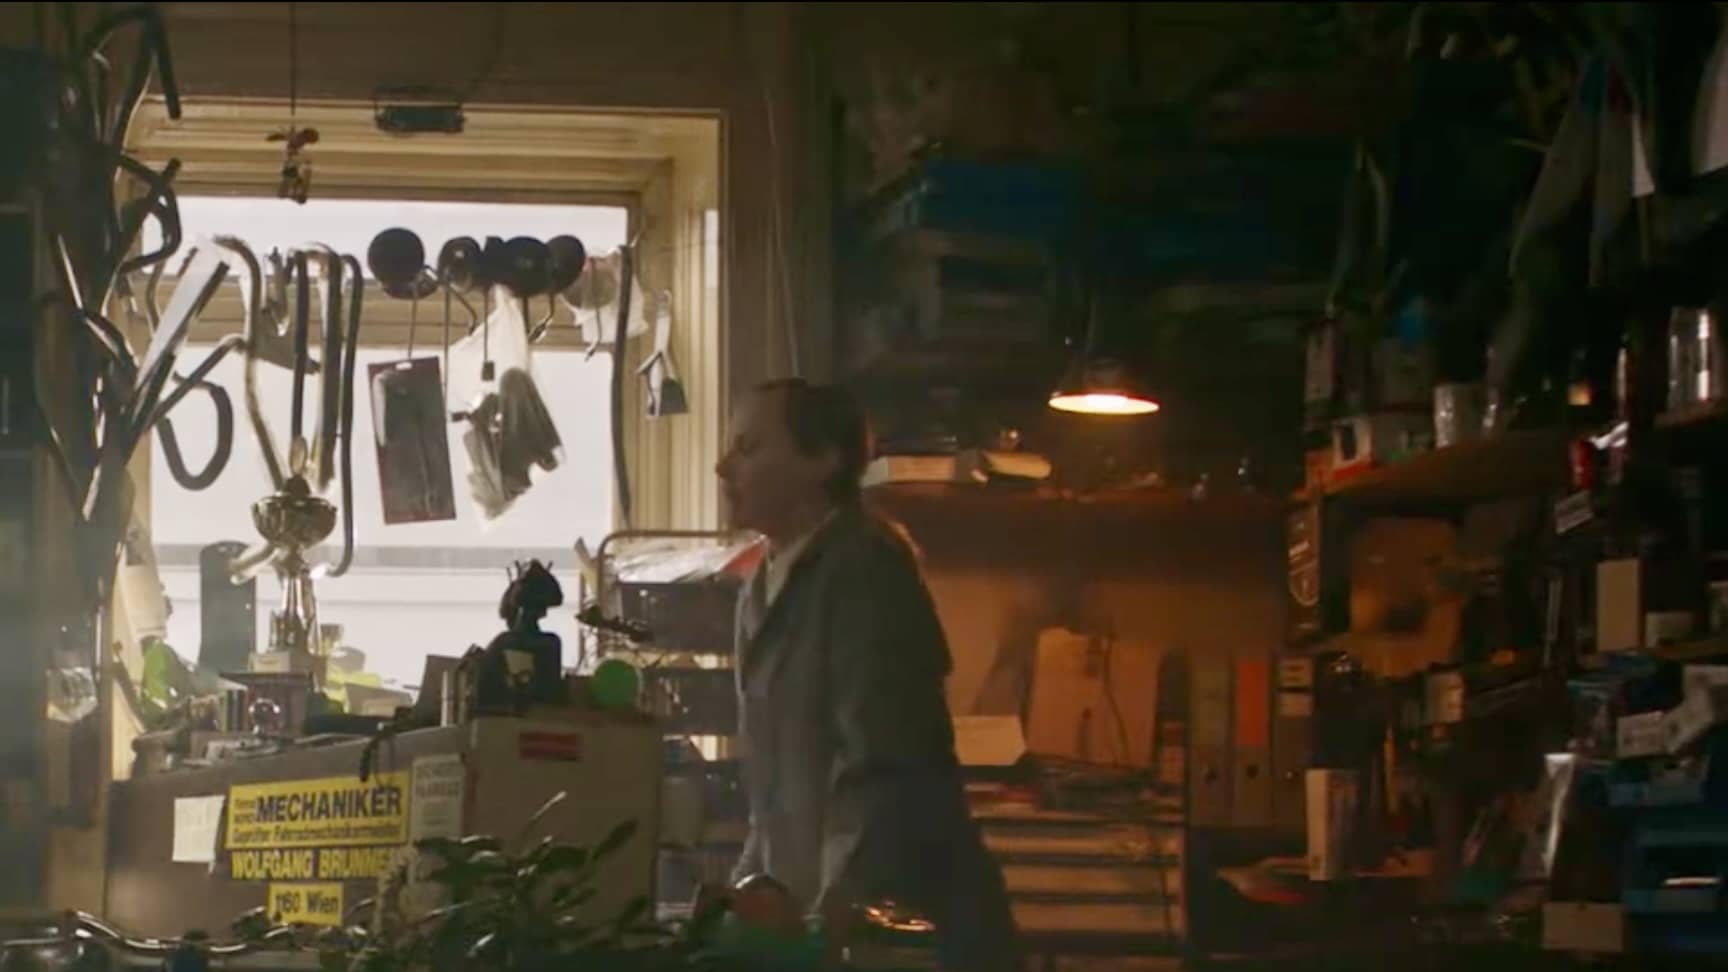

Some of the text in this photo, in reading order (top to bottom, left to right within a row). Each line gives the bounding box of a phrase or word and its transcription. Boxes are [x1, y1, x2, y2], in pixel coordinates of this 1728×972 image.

[255, 786, 402, 823] MECHANIKER
[232, 849, 313, 878] WOLFGANG
[306, 889, 339, 914] Wien
